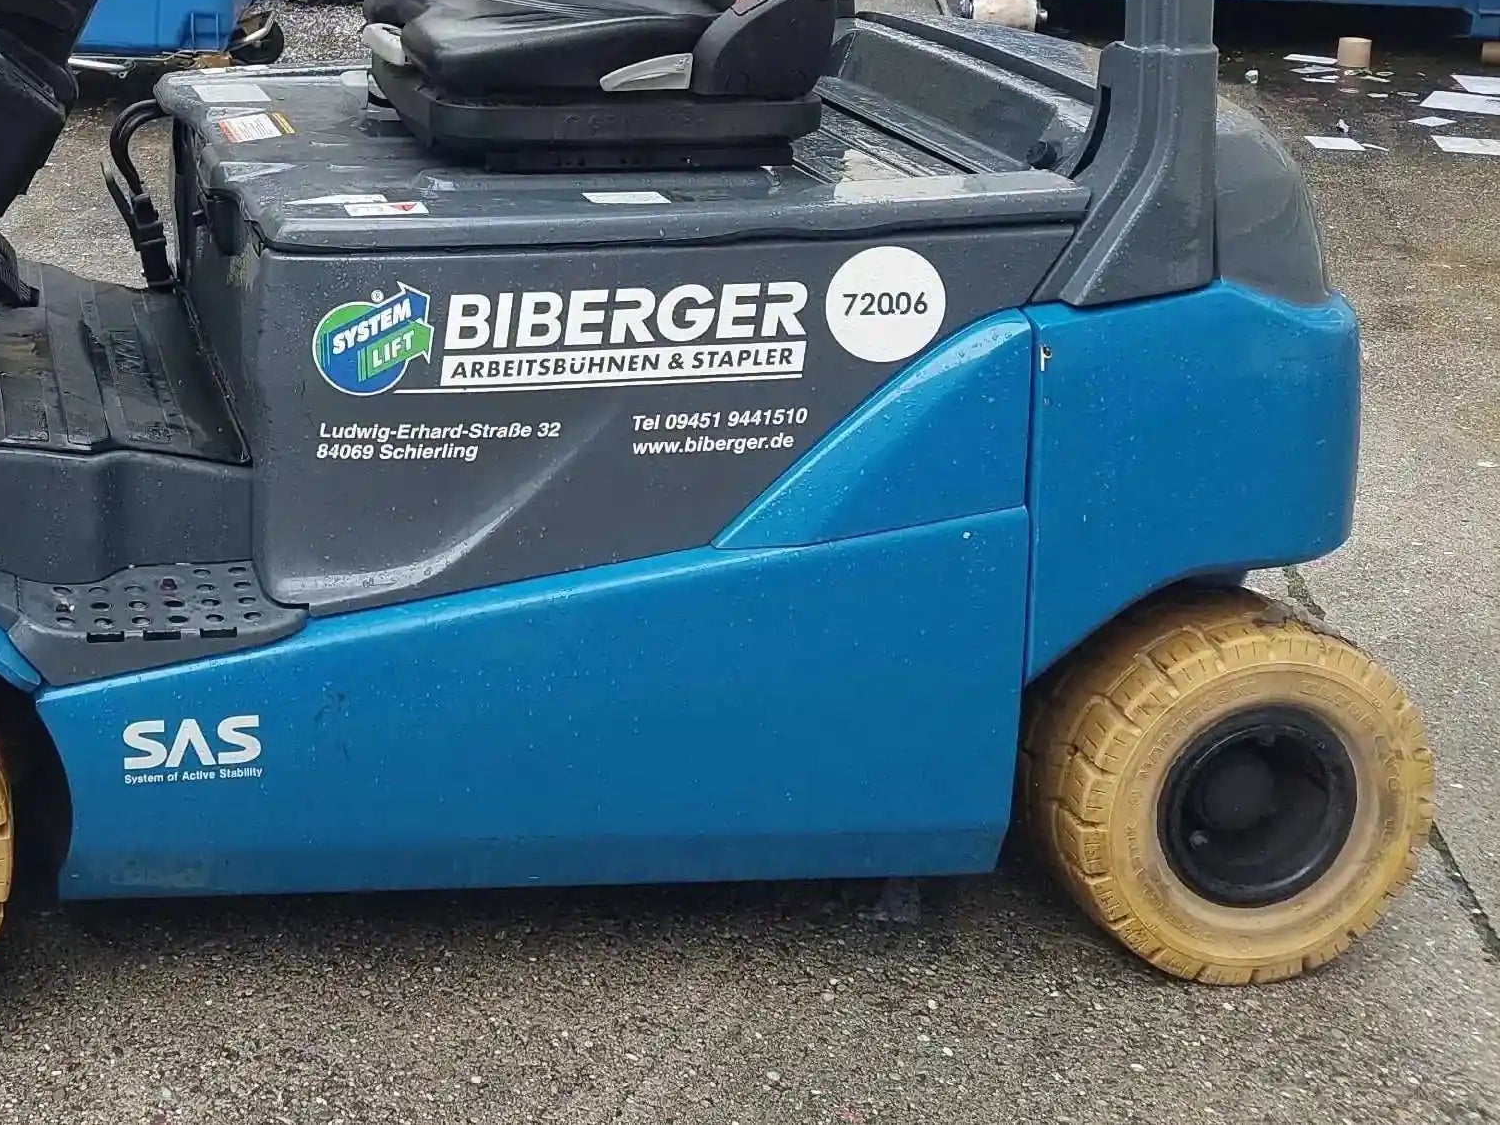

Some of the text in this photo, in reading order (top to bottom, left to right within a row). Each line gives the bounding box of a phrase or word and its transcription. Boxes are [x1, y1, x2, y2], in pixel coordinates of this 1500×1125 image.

[444, 281, 808, 350] BIBERGER
[842, 291, 928, 317] 72006
[332, 298, 412, 355] SYSTEM
[372, 331, 415, 367] LIFT
[450, 347, 794, 379] ARBEITSBÜHNEN & STAPLER
[319, 422, 562, 443] Ludwig-Erhard-Straße 32
[632, 407, 808, 432] Tel 09451 9441510
[316, 443, 479, 462] 84069 Schierling
[632, 432, 795, 456] www.biberger.de
[122, 714, 262, 770] SAS
[124, 767, 263, 786] System of Active Stability
